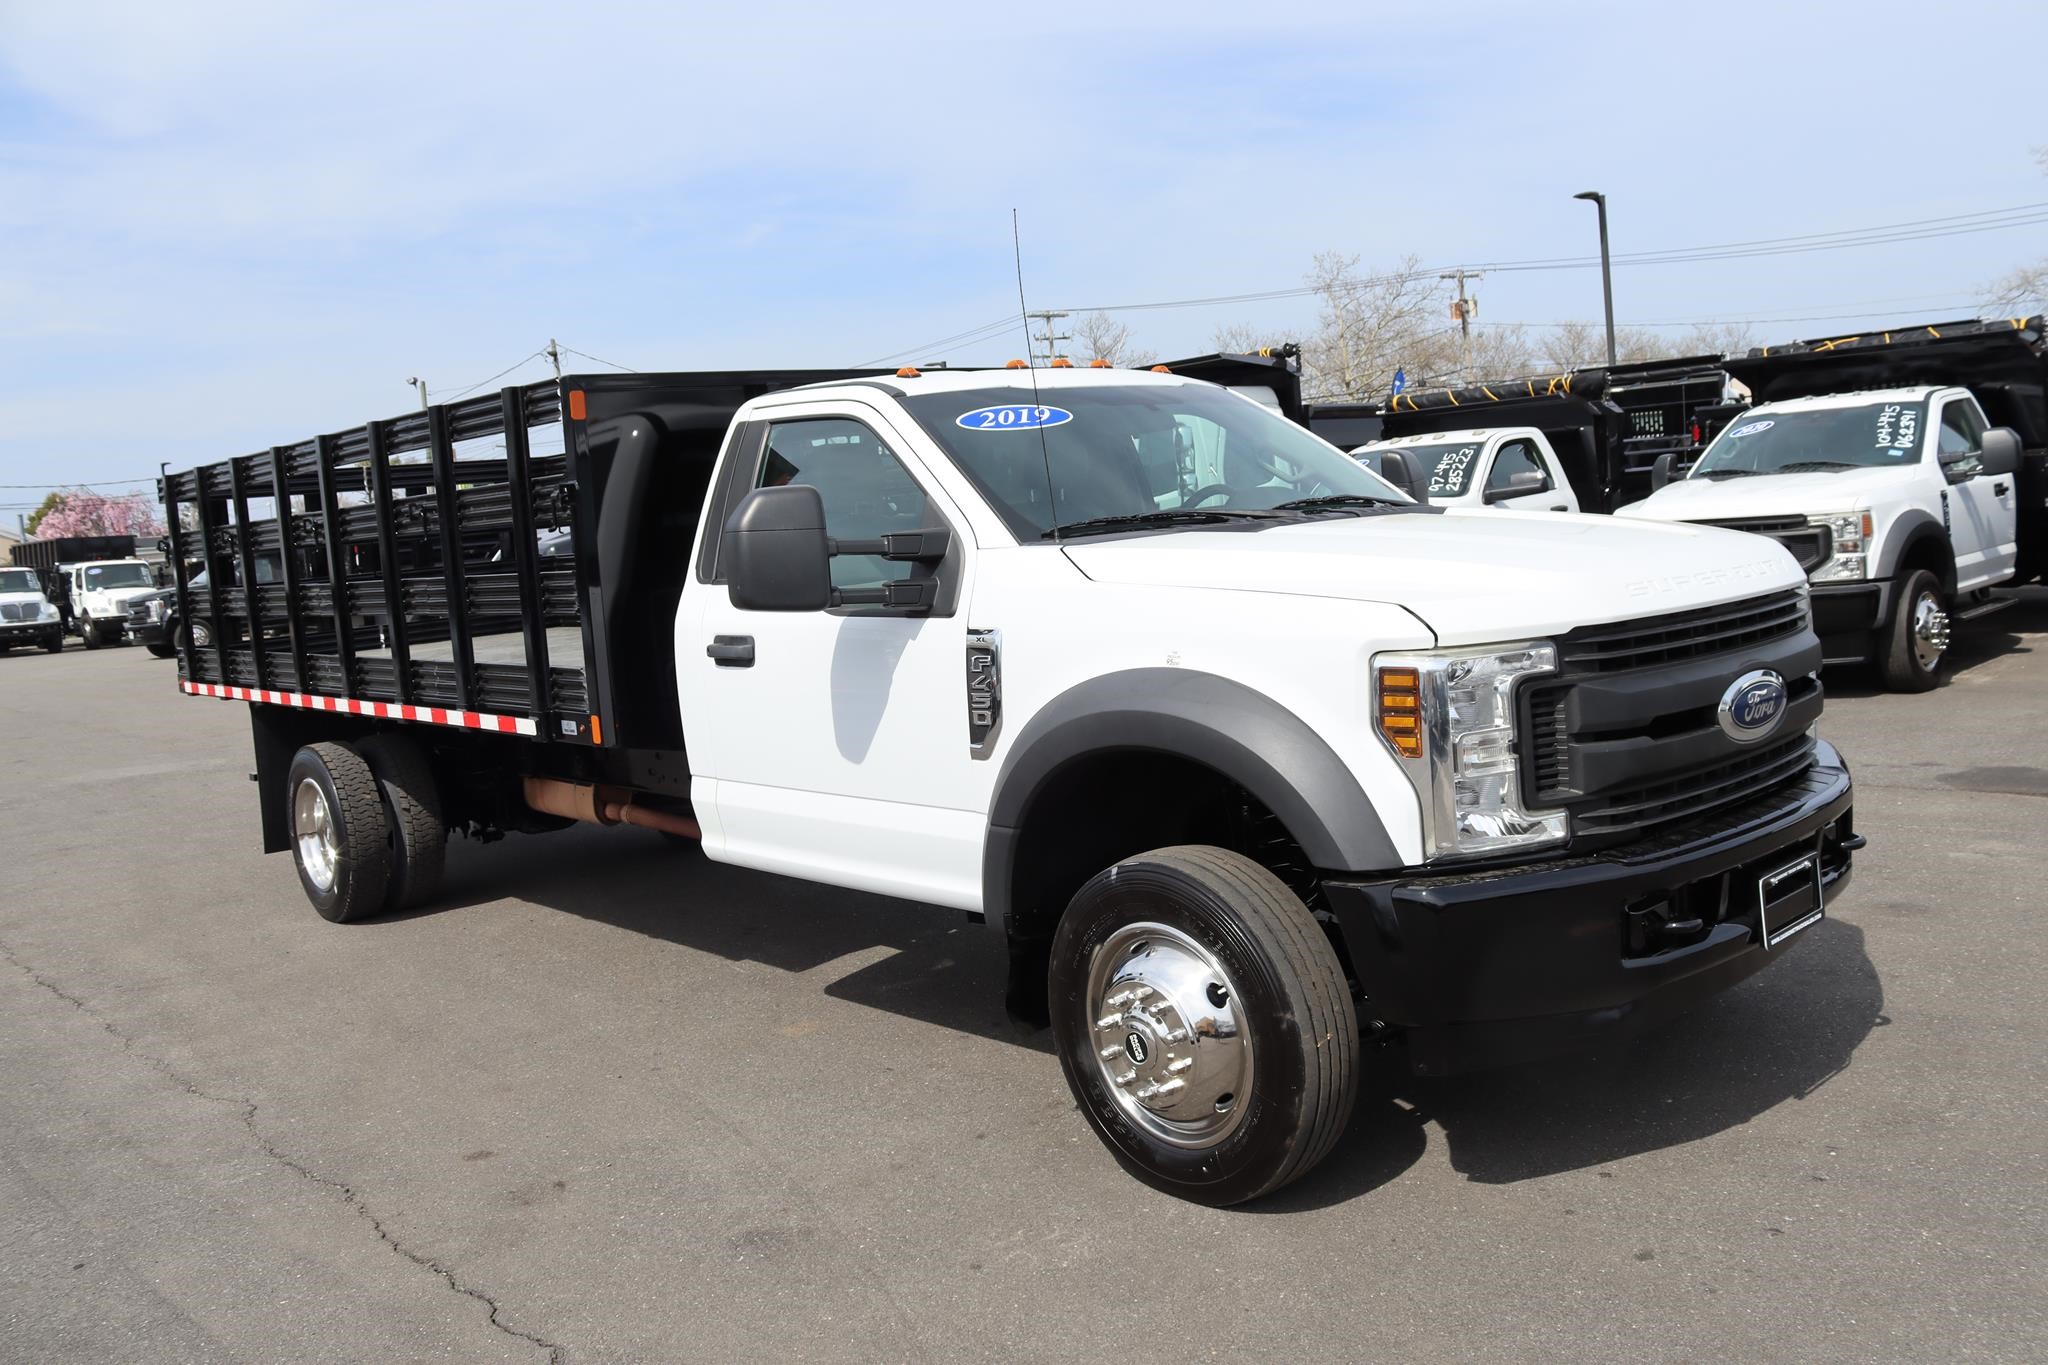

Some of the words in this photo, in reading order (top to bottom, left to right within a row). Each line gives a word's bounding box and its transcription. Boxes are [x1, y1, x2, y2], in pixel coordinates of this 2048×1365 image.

[979, 407, 1051, 428] 2019
[1445, 448, 1474, 491] 285223
[1624, 567, 1730, 600] SUPER
[1744, 688, 1776, 722] Ford
